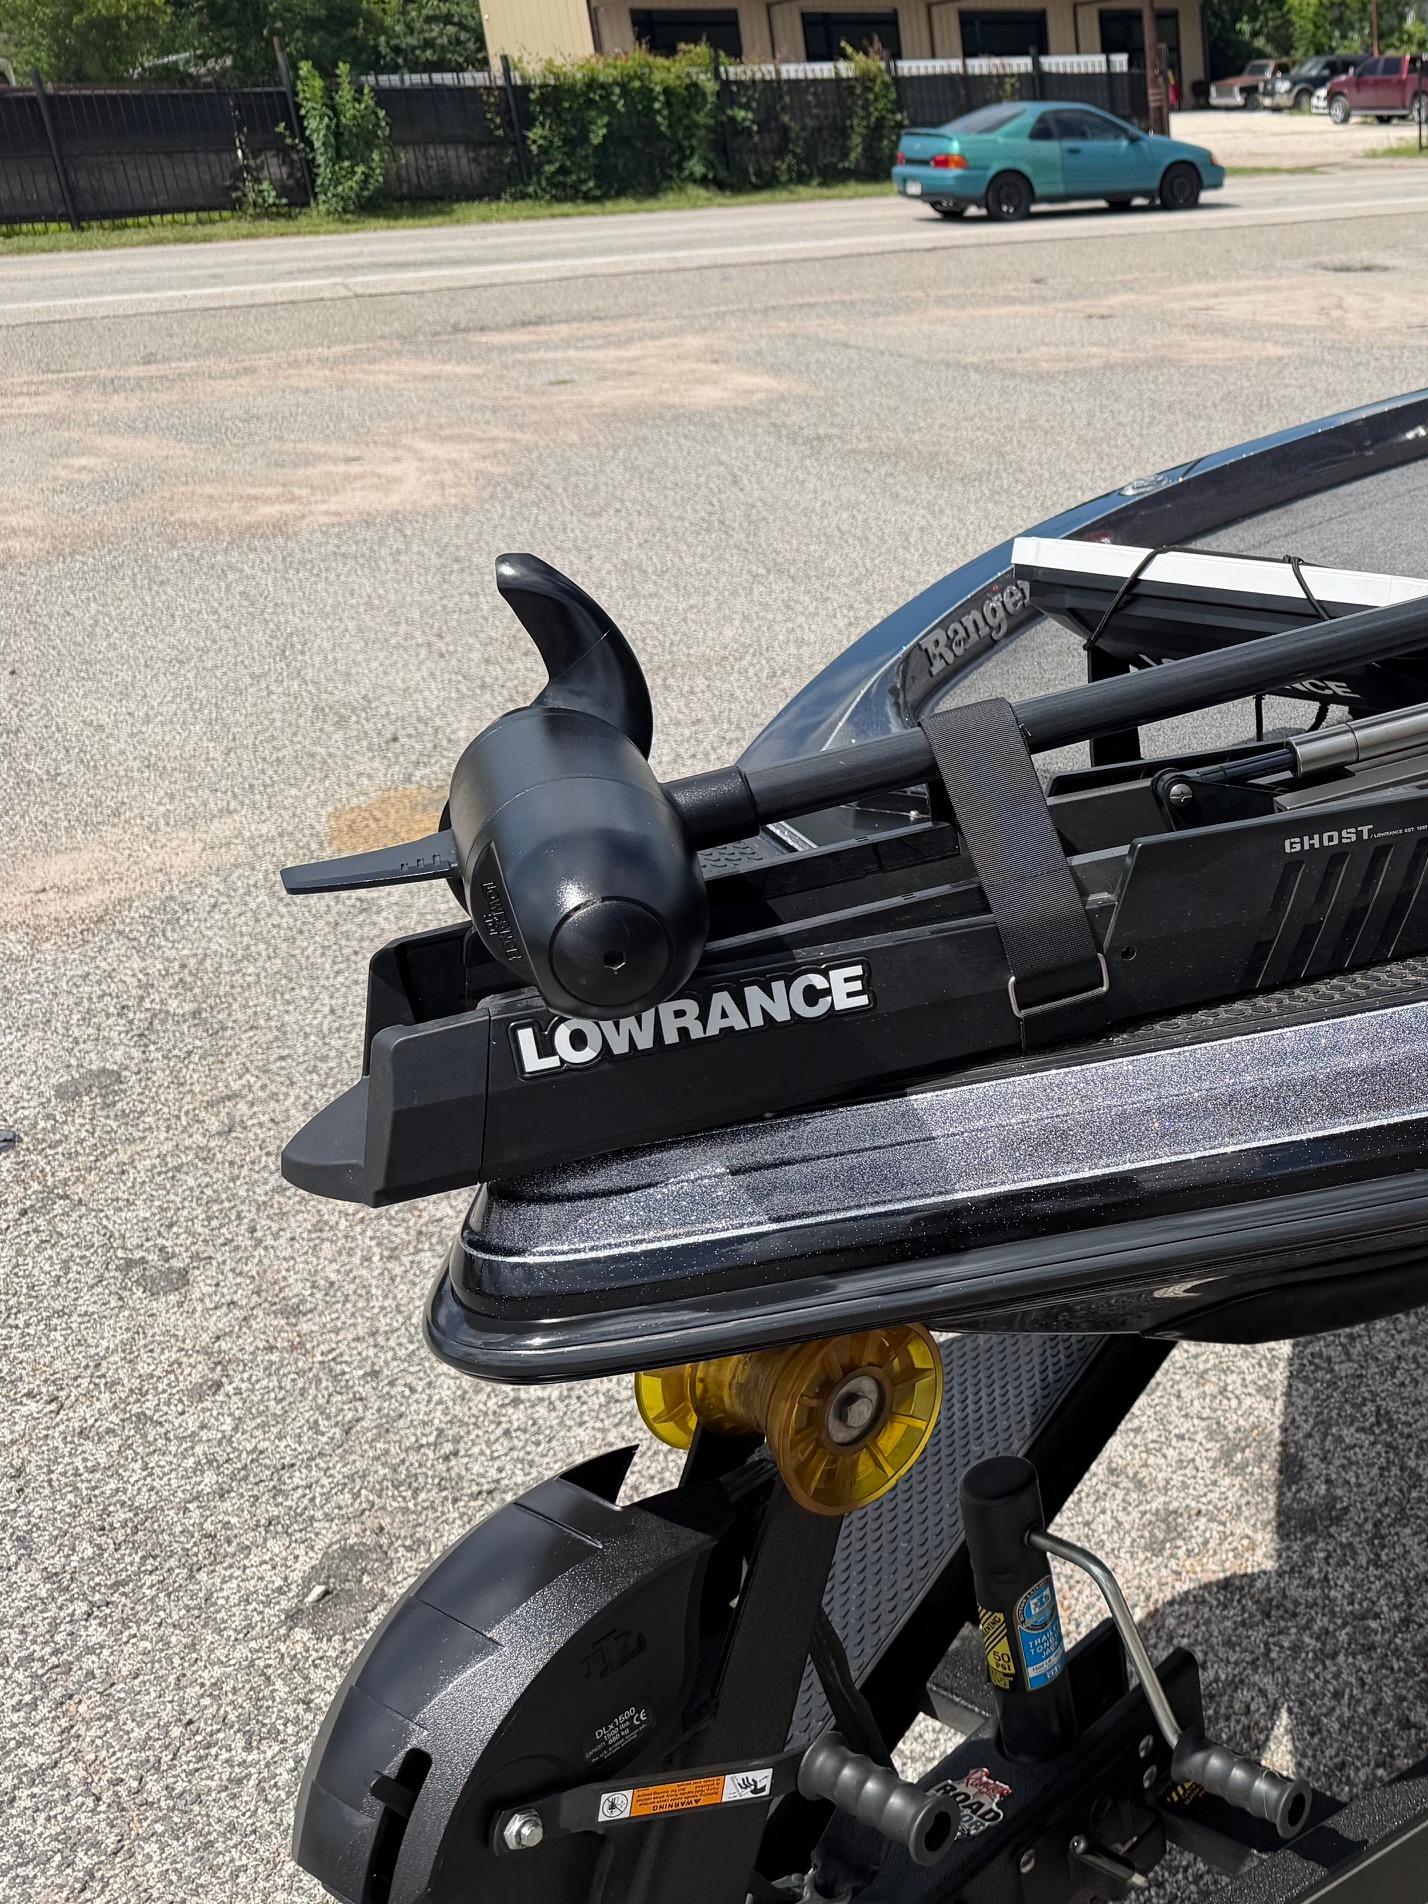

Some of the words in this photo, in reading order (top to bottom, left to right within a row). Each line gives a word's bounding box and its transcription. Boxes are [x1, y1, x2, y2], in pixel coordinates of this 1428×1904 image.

[919, 579, 1030, 676] Ranger
[1284, 825, 1373, 853] GHOST
[517, 964, 869, 1073] LOWRANCE
[595, 1706, 636, 1739] DLx1500
[652, 1799, 694, 1811] WARNING
[934, 1784, 1001, 1823] ROAD
